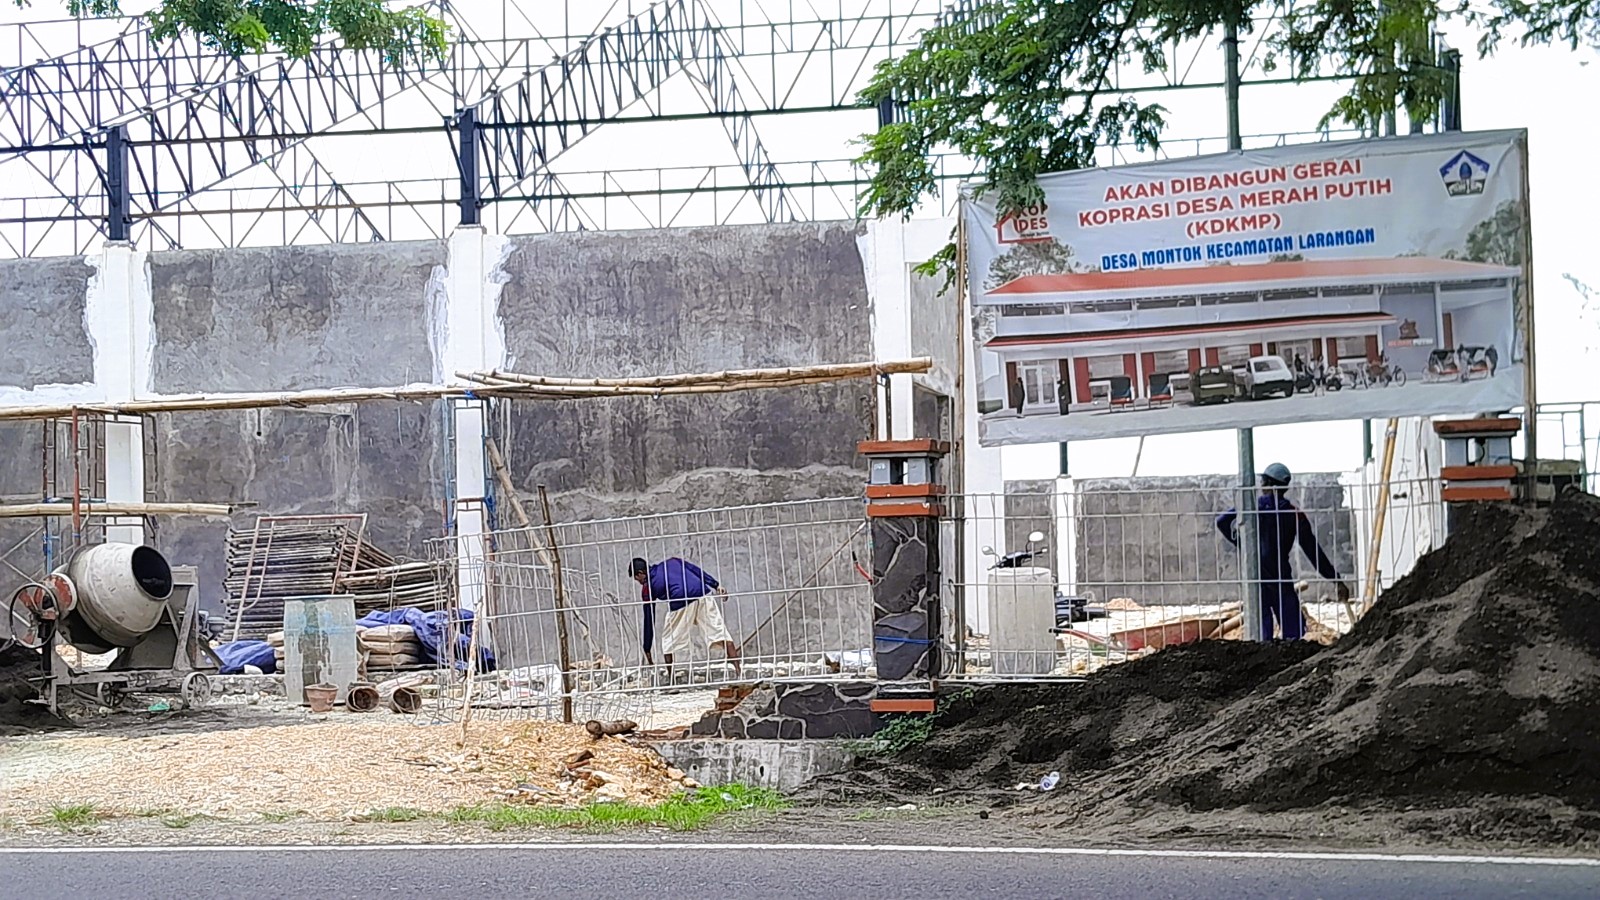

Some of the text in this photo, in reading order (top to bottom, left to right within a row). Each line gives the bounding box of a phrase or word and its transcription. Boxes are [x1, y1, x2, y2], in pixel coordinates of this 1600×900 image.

[1104, 159, 1362, 202] AKAN DIBANGUN GERAI
[1079, 178, 1392, 227] KOPRASI DESA MERAH PUTIH
[1019, 217, 1048, 232] DES
[1186, 213, 1281, 239] (KDKMP)
[1102, 227, 1375, 271] DESA MONTOK KECAMATAN LARANGAN
